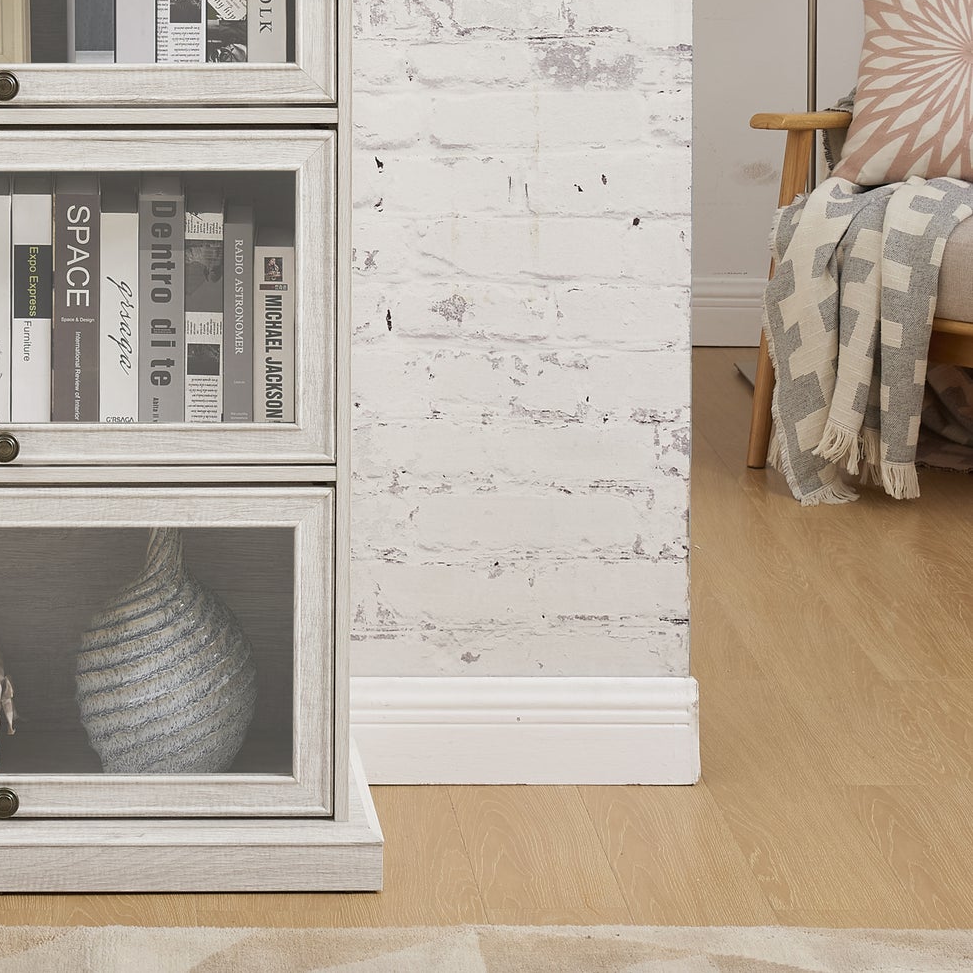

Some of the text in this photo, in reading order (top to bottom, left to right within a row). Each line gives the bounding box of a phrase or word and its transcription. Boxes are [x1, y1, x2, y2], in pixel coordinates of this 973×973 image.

[27, 247, 38, 317] Expo Express
[66, 205, 90, 307] SPACE
[151, 201, 177, 386] Dentro di te
[235, 239, 243, 355] RADIO ASTRONOMER
[265, 295, 283, 353] MICHAEL
[23, 321, 32, 361] Furniture
[265, 357, 283, 418] JACKSON
